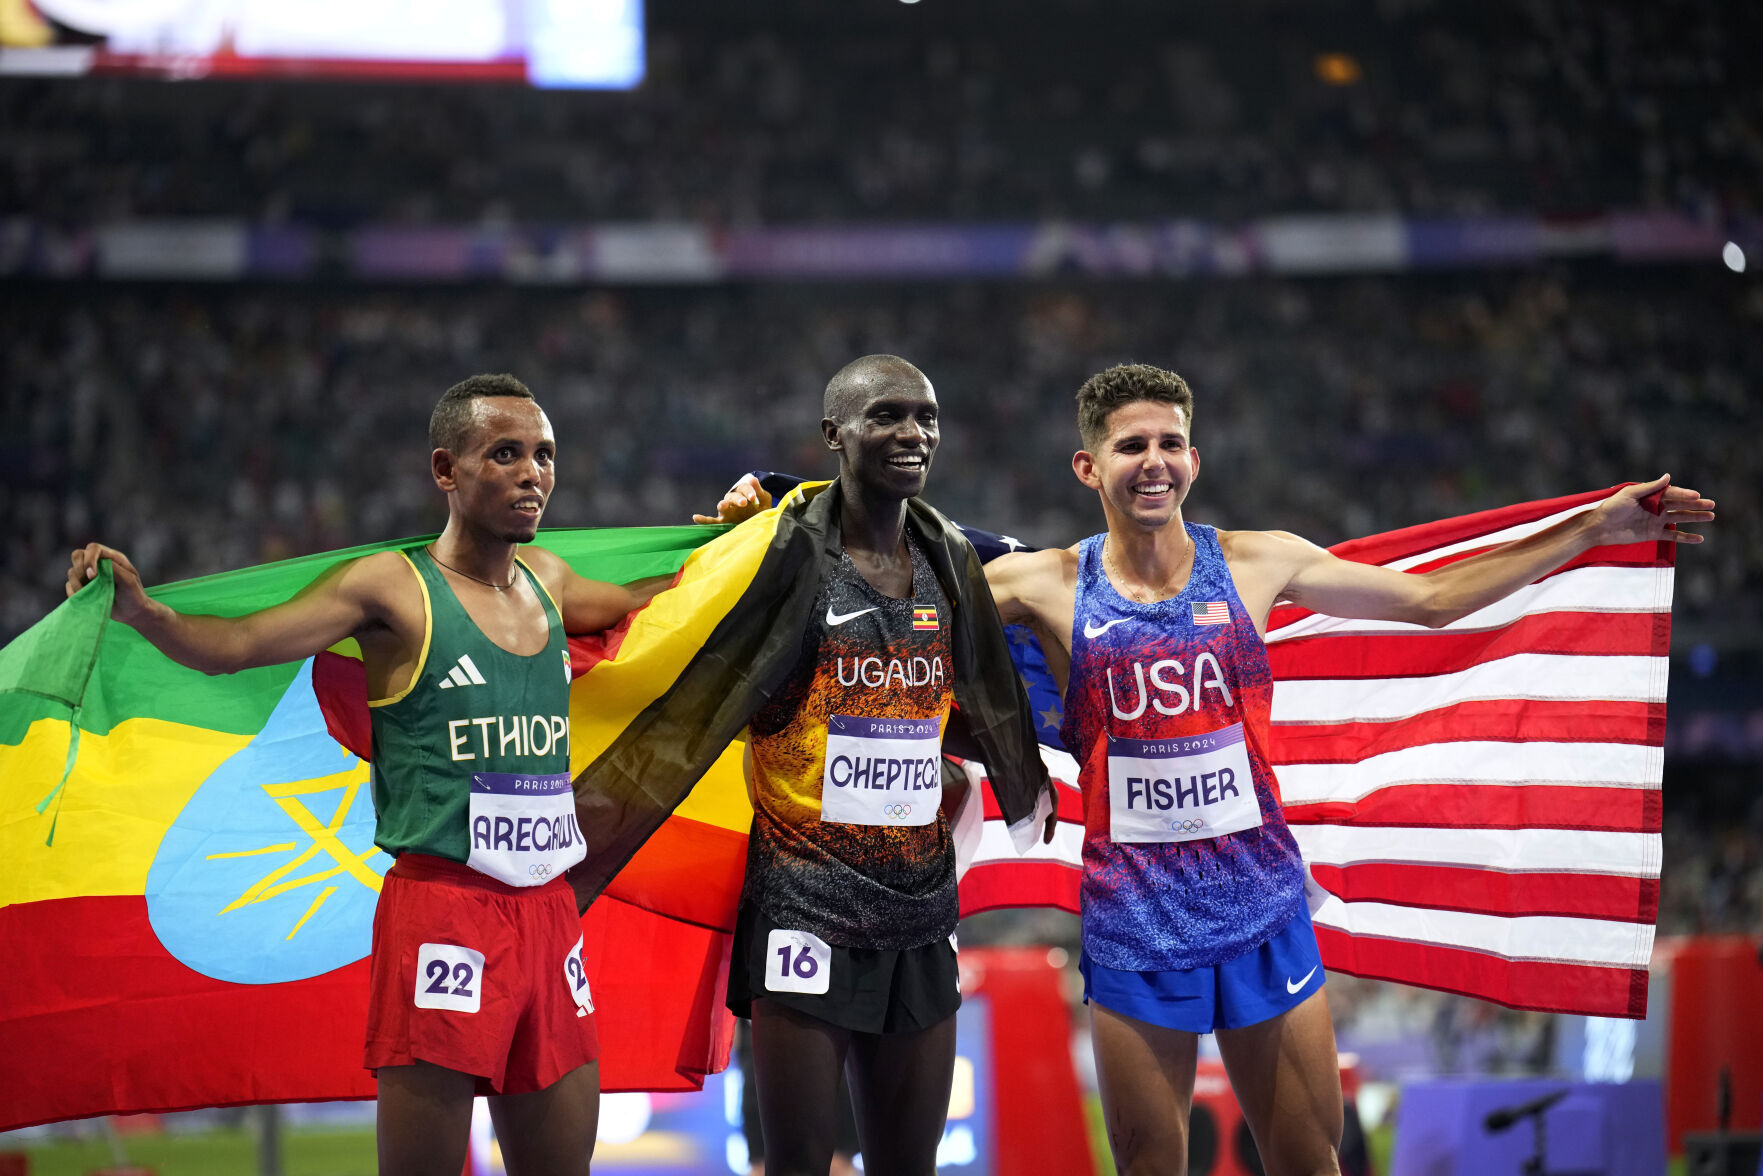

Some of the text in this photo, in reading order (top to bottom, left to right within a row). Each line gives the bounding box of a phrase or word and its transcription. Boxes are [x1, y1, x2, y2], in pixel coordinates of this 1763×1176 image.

[837, 656, 944, 688] UGANDA
[1107, 652, 1233, 720] USA
[870, 723, 933, 734] PARIS 2024
[1142, 738, 1216, 754] PARIS 2024
[514, 779, 548, 790] PARIS
[1126, 767, 1240, 810] FISHER
[473, 813, 583, 851] AREGAWI
[424, 959, 474, 998] 22
[568, 947, 587, 991] 2
[777, 945, 818, 979] 16
